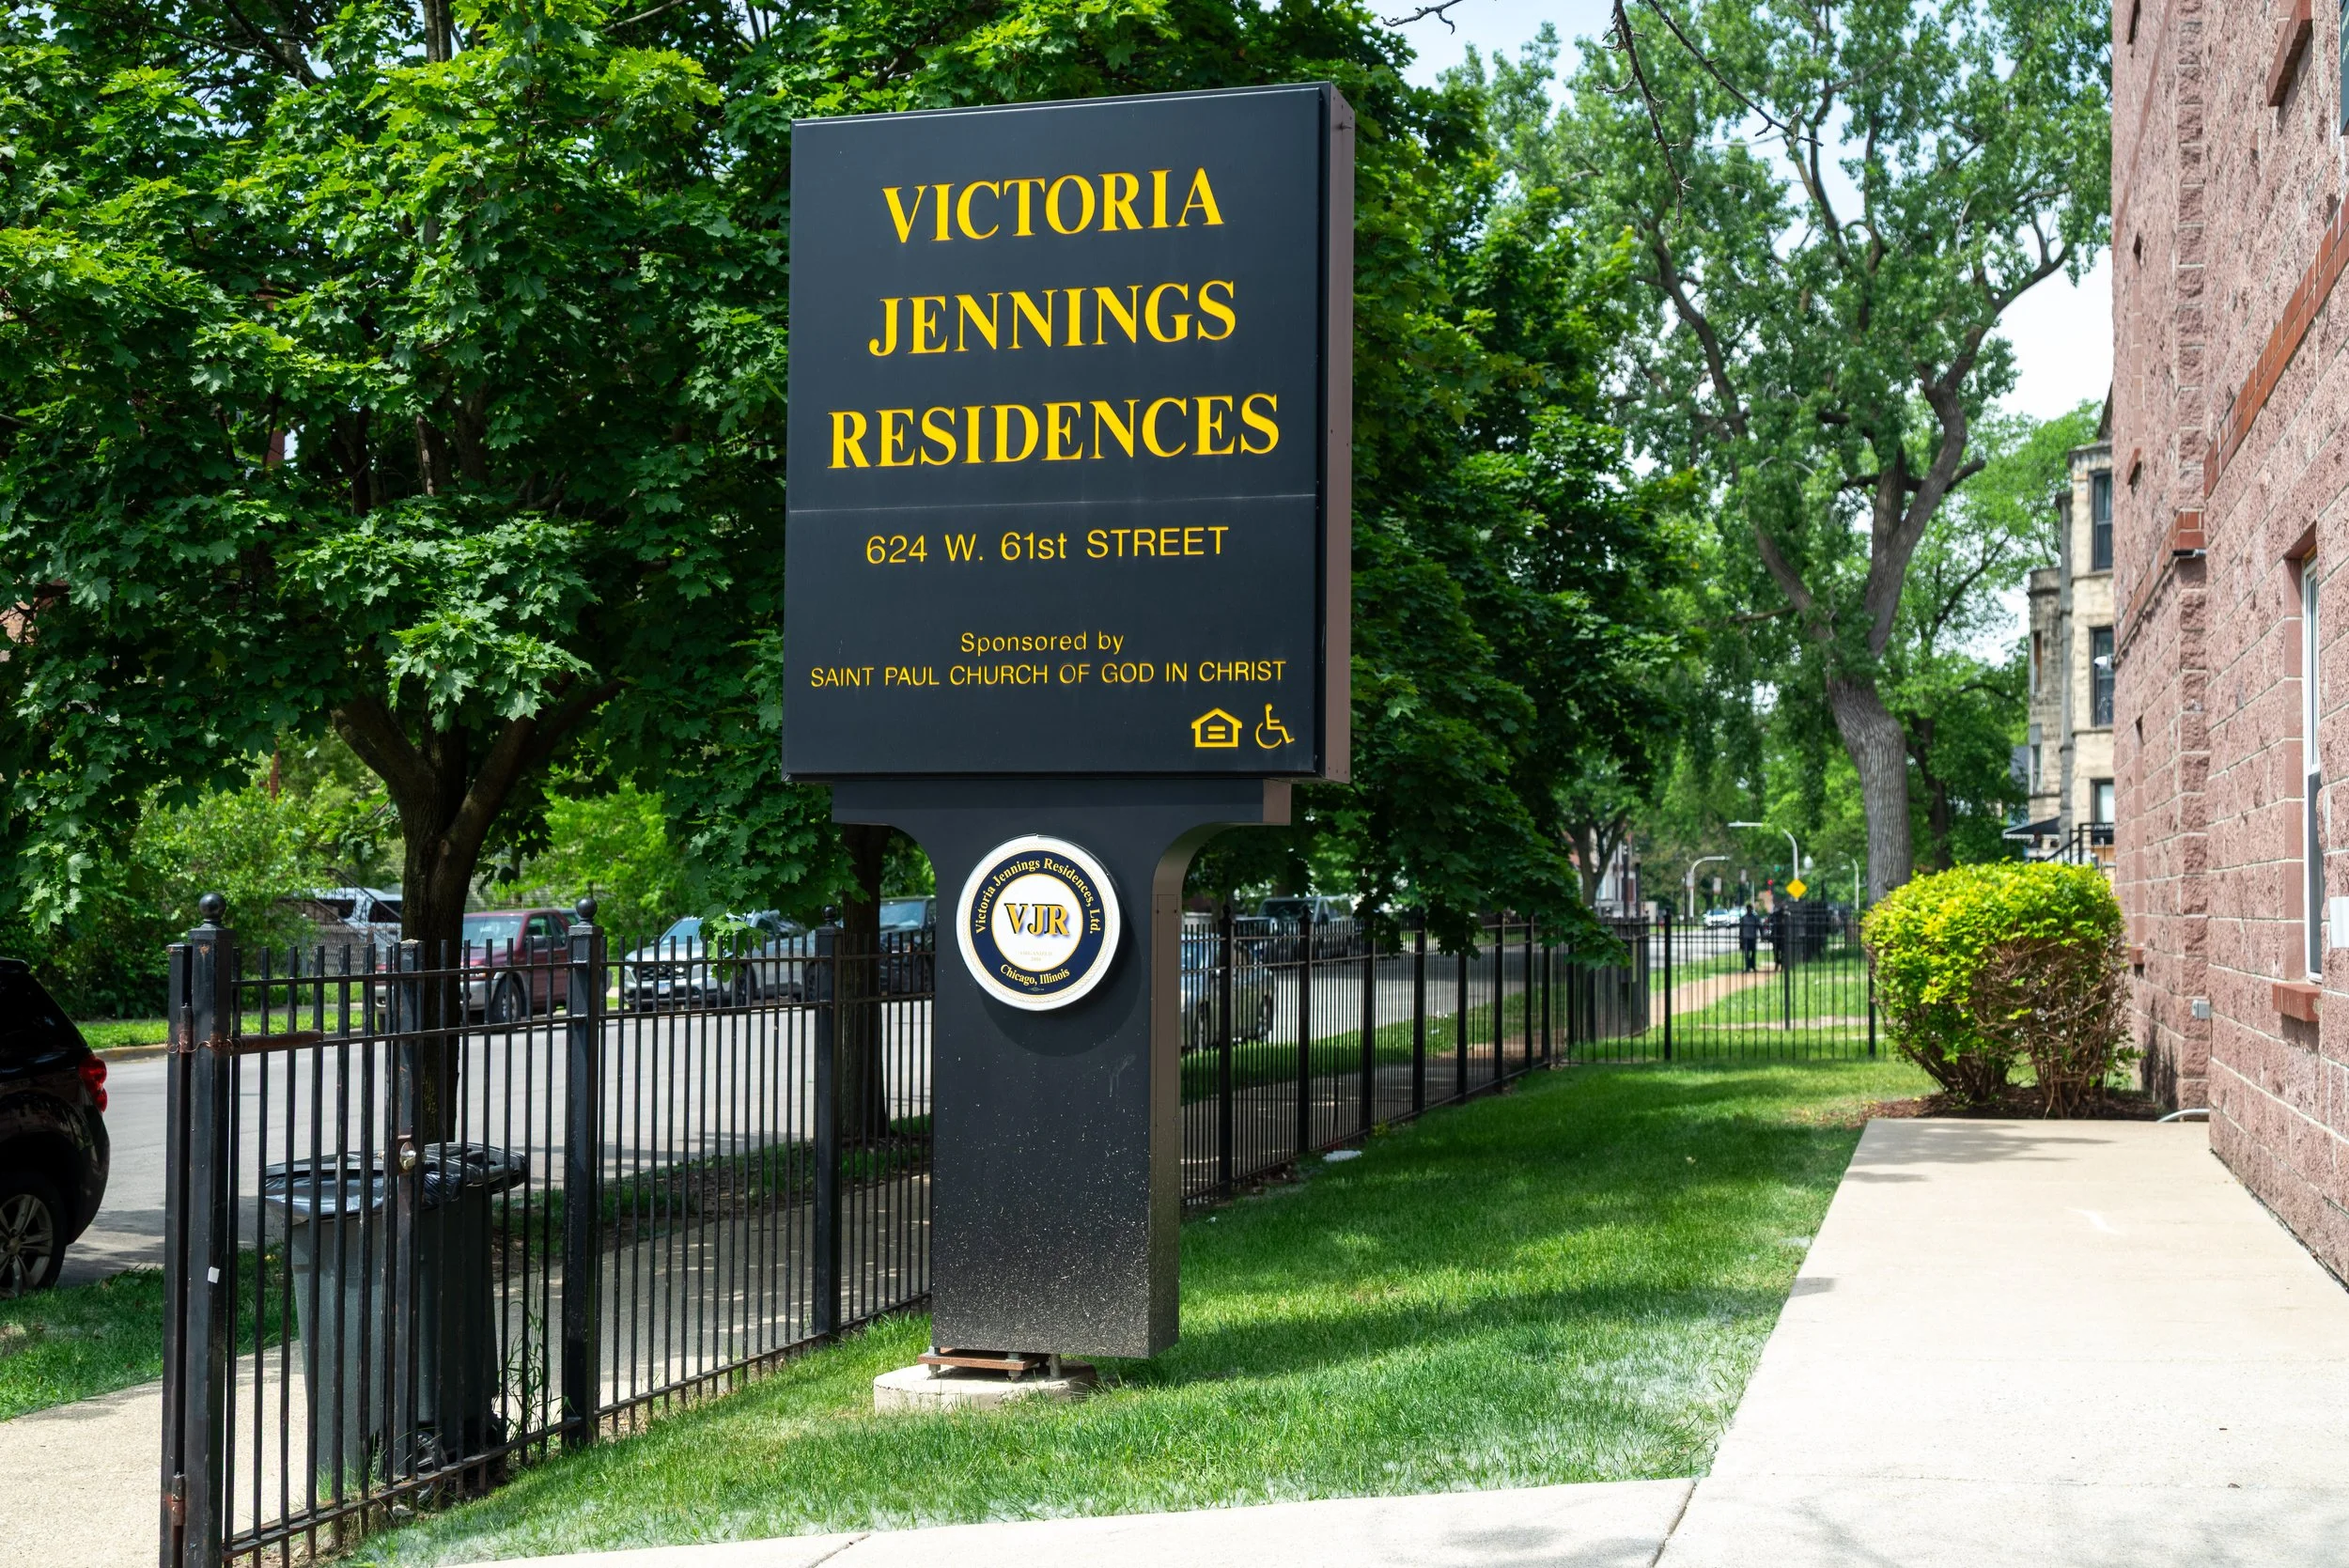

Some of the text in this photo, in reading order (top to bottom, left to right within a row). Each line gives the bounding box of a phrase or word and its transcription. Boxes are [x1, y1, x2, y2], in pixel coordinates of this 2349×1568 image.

[882, 166, 1224, 244] VICTORIA
[868, 279, 1237, 358] JENNINGS
[827, 392, 1280, 470] RESIDENCES
[865, 525, 1230, 565] 624 W. 61st STREET
[960, 630, 1124, 657] Sponsored by
[811, 660, 1287, 688] SAINT PAUL CHURCH OF GOD IN CHRIST
[975, 858, 1101, 934] Victoria Jennings Residences, Ltd.
[1003, 903, 1070, 936] VJR
[1000, 964, 1070, 986] Chicago, Illinois
